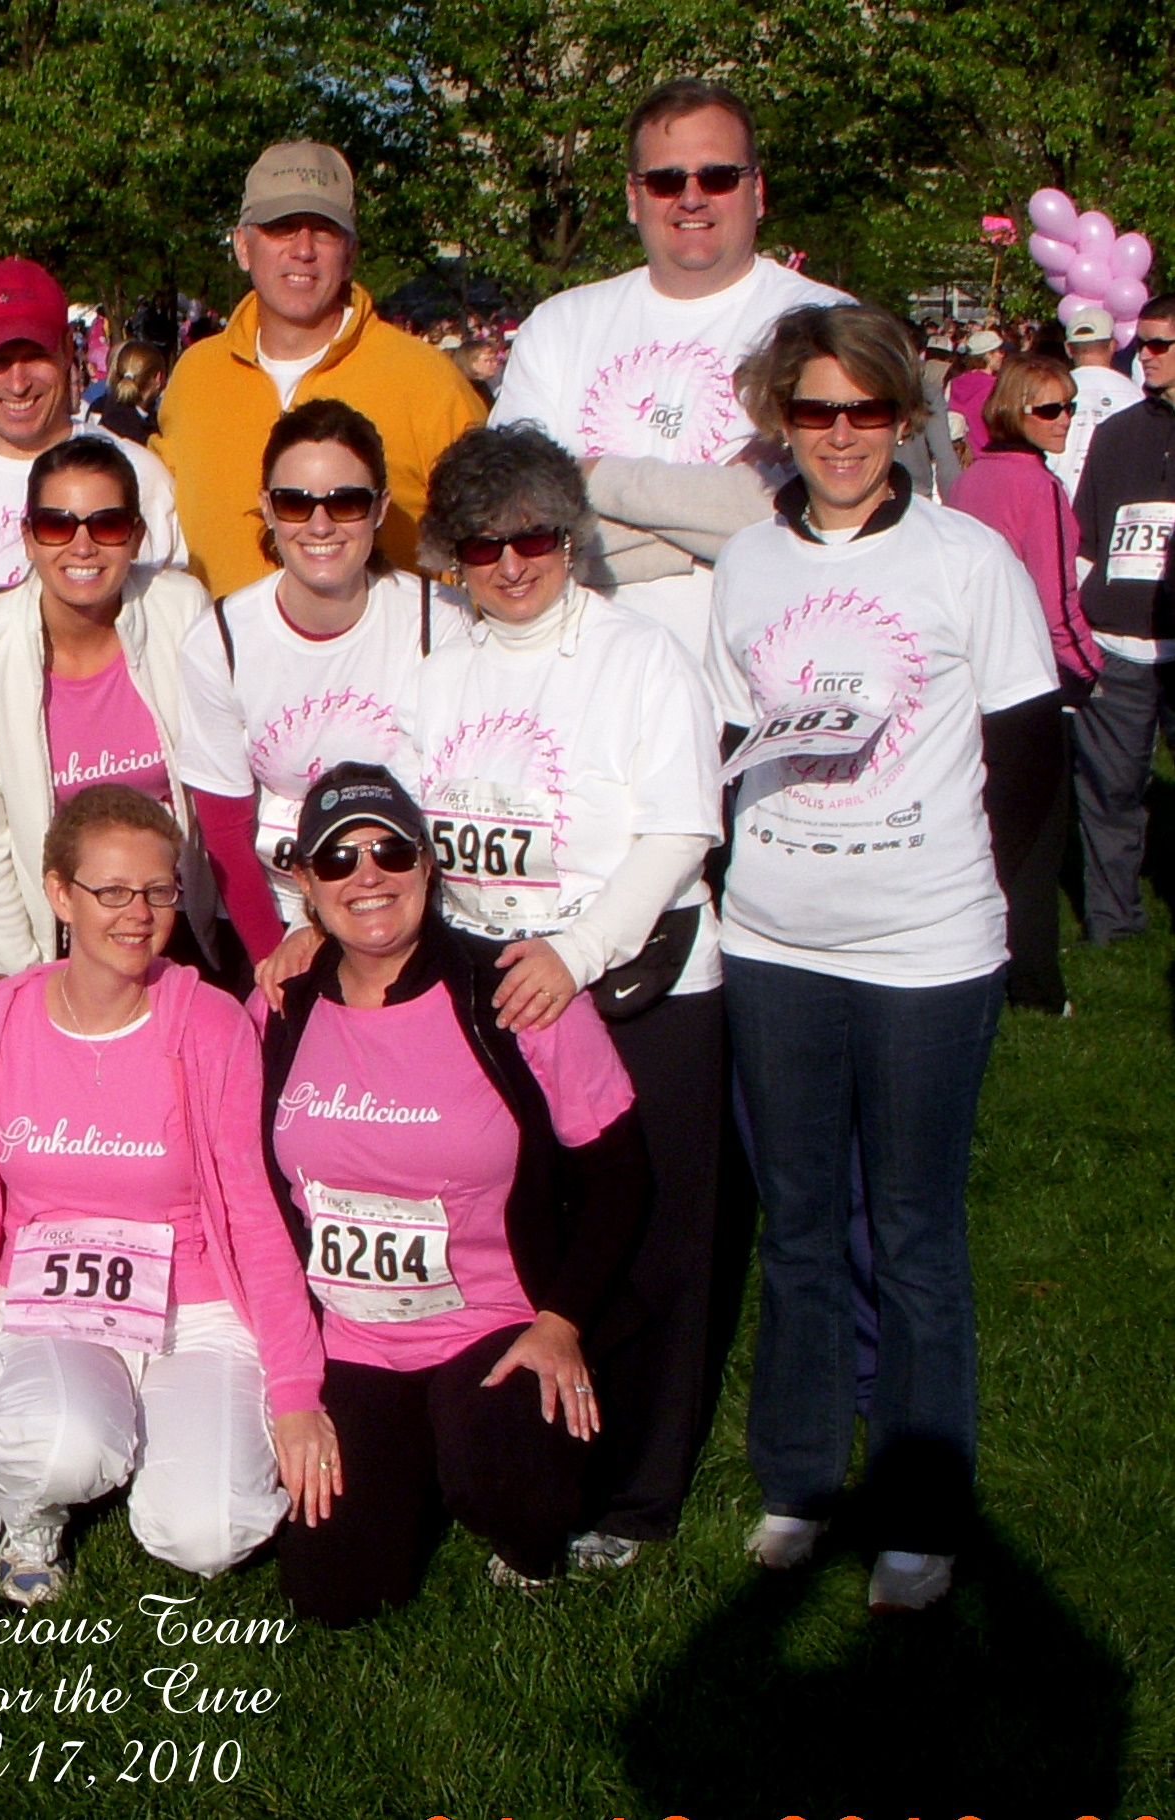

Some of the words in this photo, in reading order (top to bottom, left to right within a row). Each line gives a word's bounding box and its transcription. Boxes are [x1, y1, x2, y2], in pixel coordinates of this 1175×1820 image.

[1112, 525, 1171, 552] 3735
[54, 749, 164, 787] nkaliciou
[785, 786, 824, 809] APOLIS
[828, 795, 865, 810] APRIL
[884, 763, 906, 788] 2010
[433, 820, 532, 876] 5967
[43, 1253, 133, 1302] 558
[321, 1225, 429, 1282] 6264
